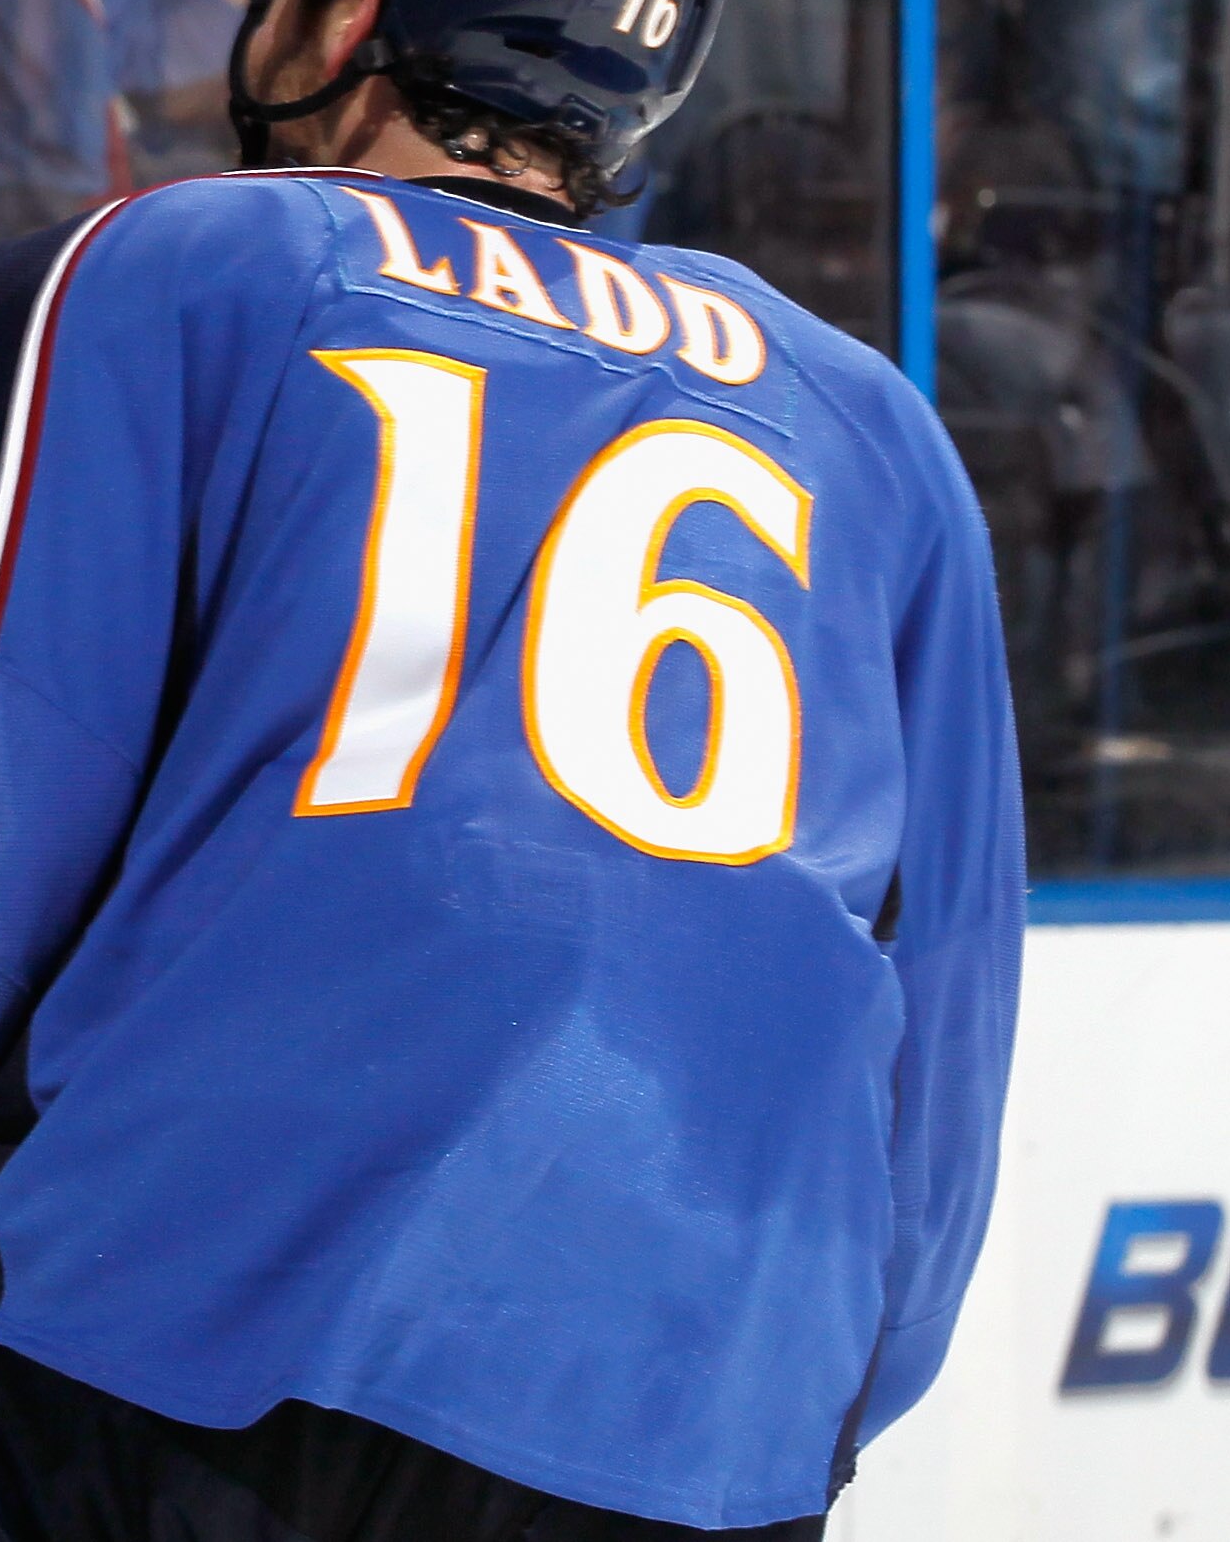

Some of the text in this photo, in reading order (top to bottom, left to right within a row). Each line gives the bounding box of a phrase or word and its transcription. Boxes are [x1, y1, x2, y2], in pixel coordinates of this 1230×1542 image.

[339, 185, 767, 387] LADD
[291, 346, 815, 867] 16
[1057, 1198, 1230, 1394] B
